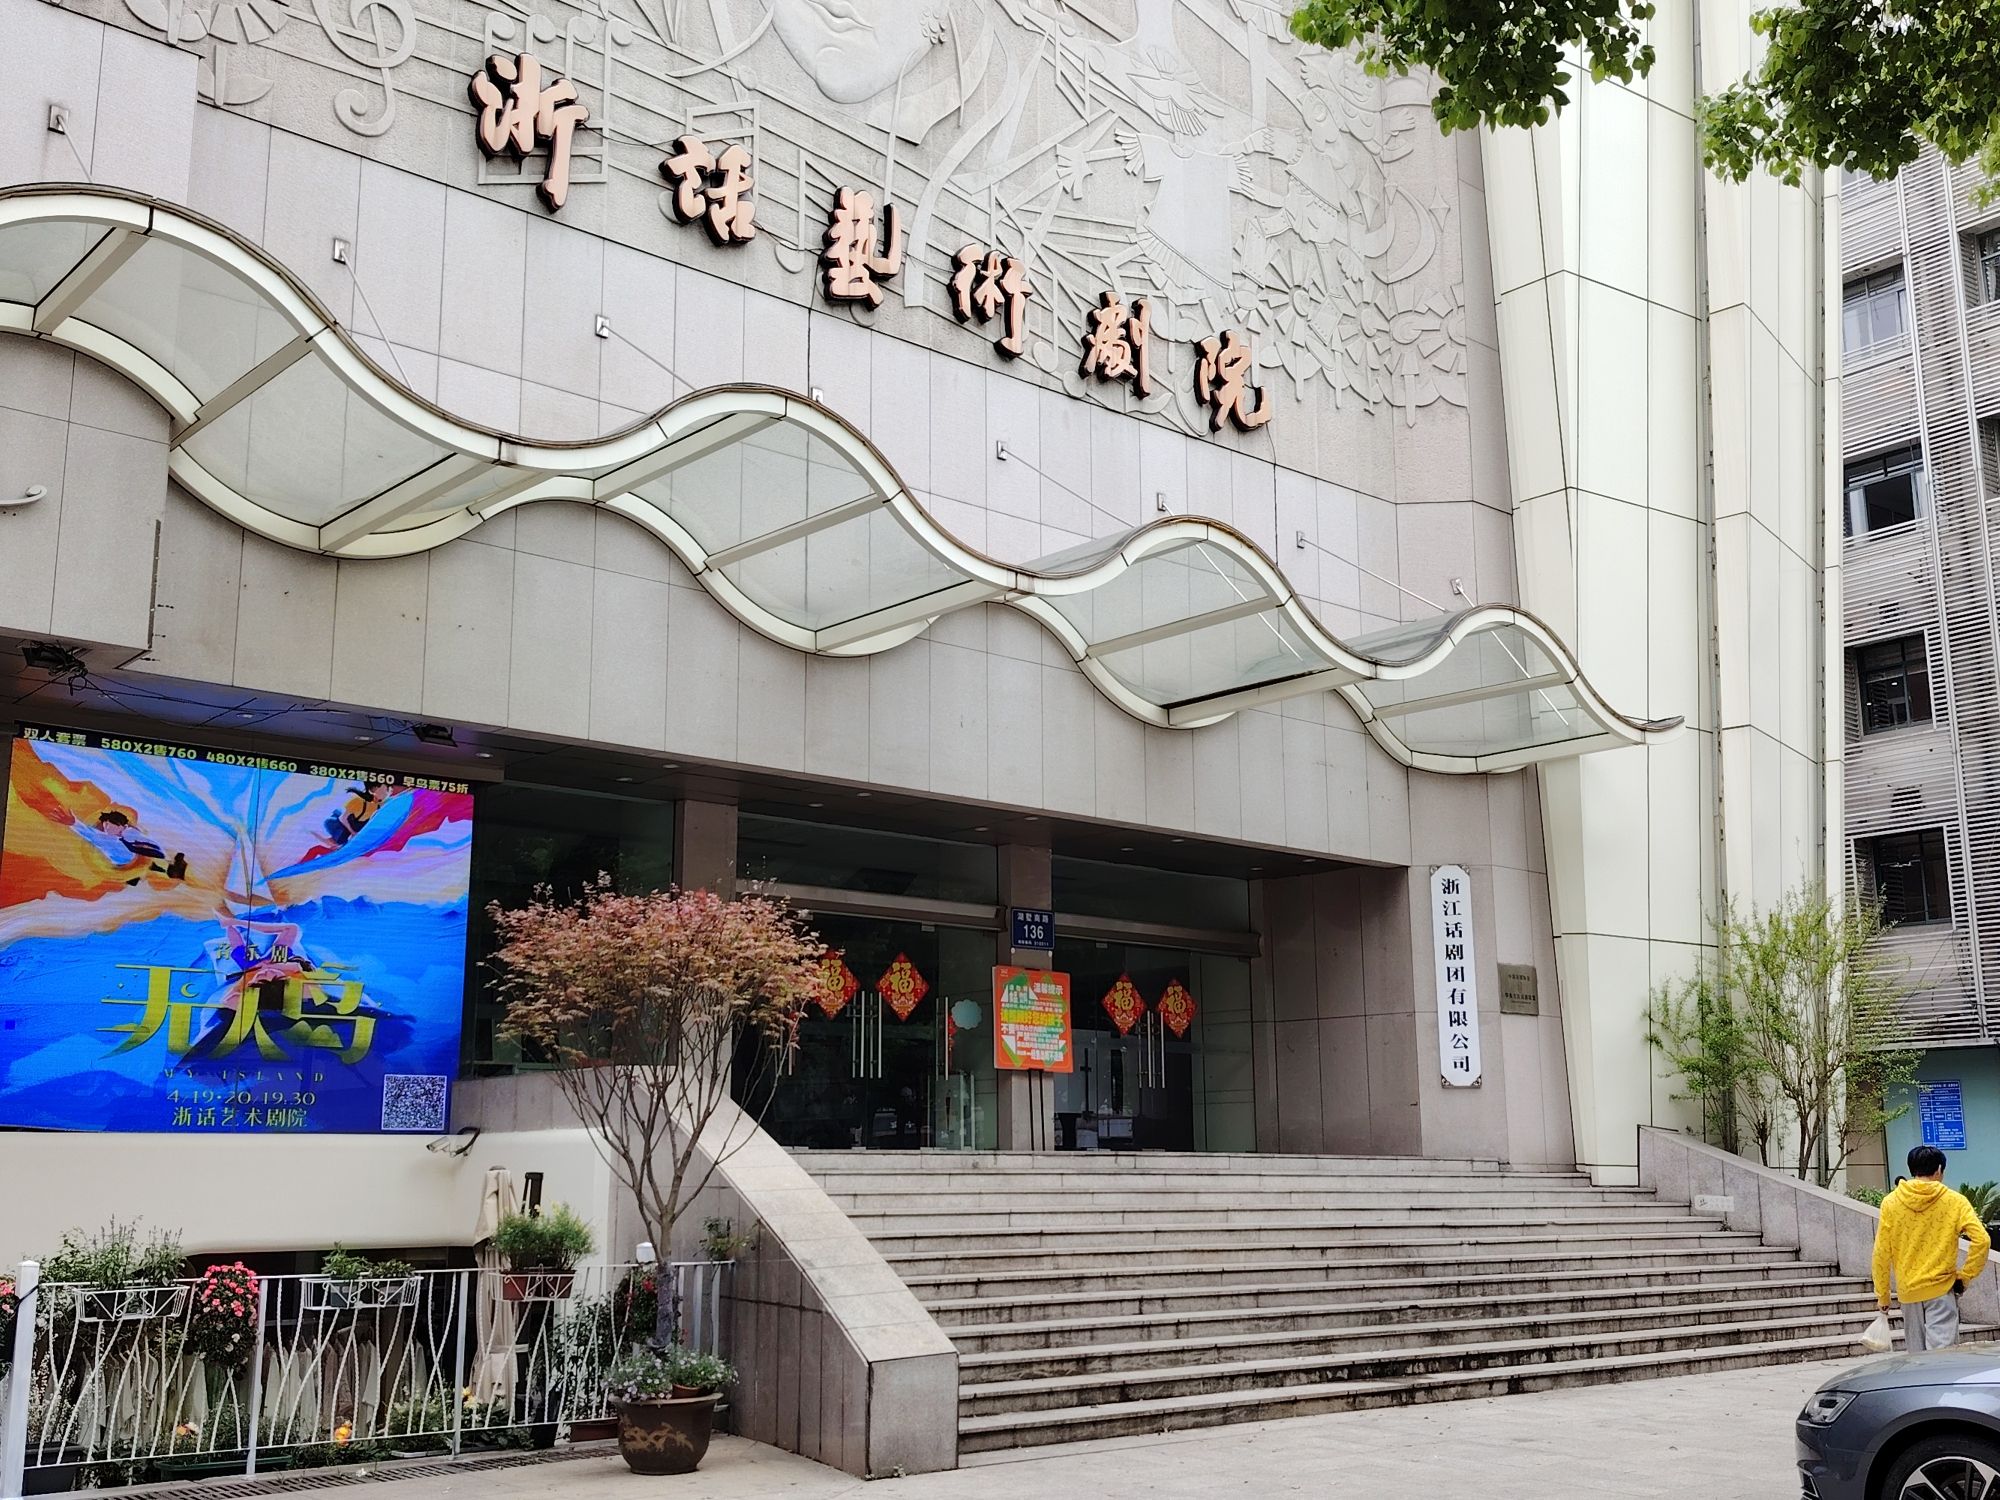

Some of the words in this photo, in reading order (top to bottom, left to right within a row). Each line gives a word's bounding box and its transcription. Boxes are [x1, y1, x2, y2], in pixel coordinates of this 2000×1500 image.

[24, 727, 87, 746] 双人套票
[403, 776, 469, 795] 早鸟票75折
[1023, 924, 1044, 939] 136
[215, 943, 289, 963] 音乐剧
[890, 962, 915, 993] 福
[1441, 878, 1470, 1072] 浙江话剧团有限公司
[1114, 981, 1135, 1011] 福
[1167, 986, 1187, 1014] 福
[171, 1106, 309, 1128] 浙话艺术剧院
